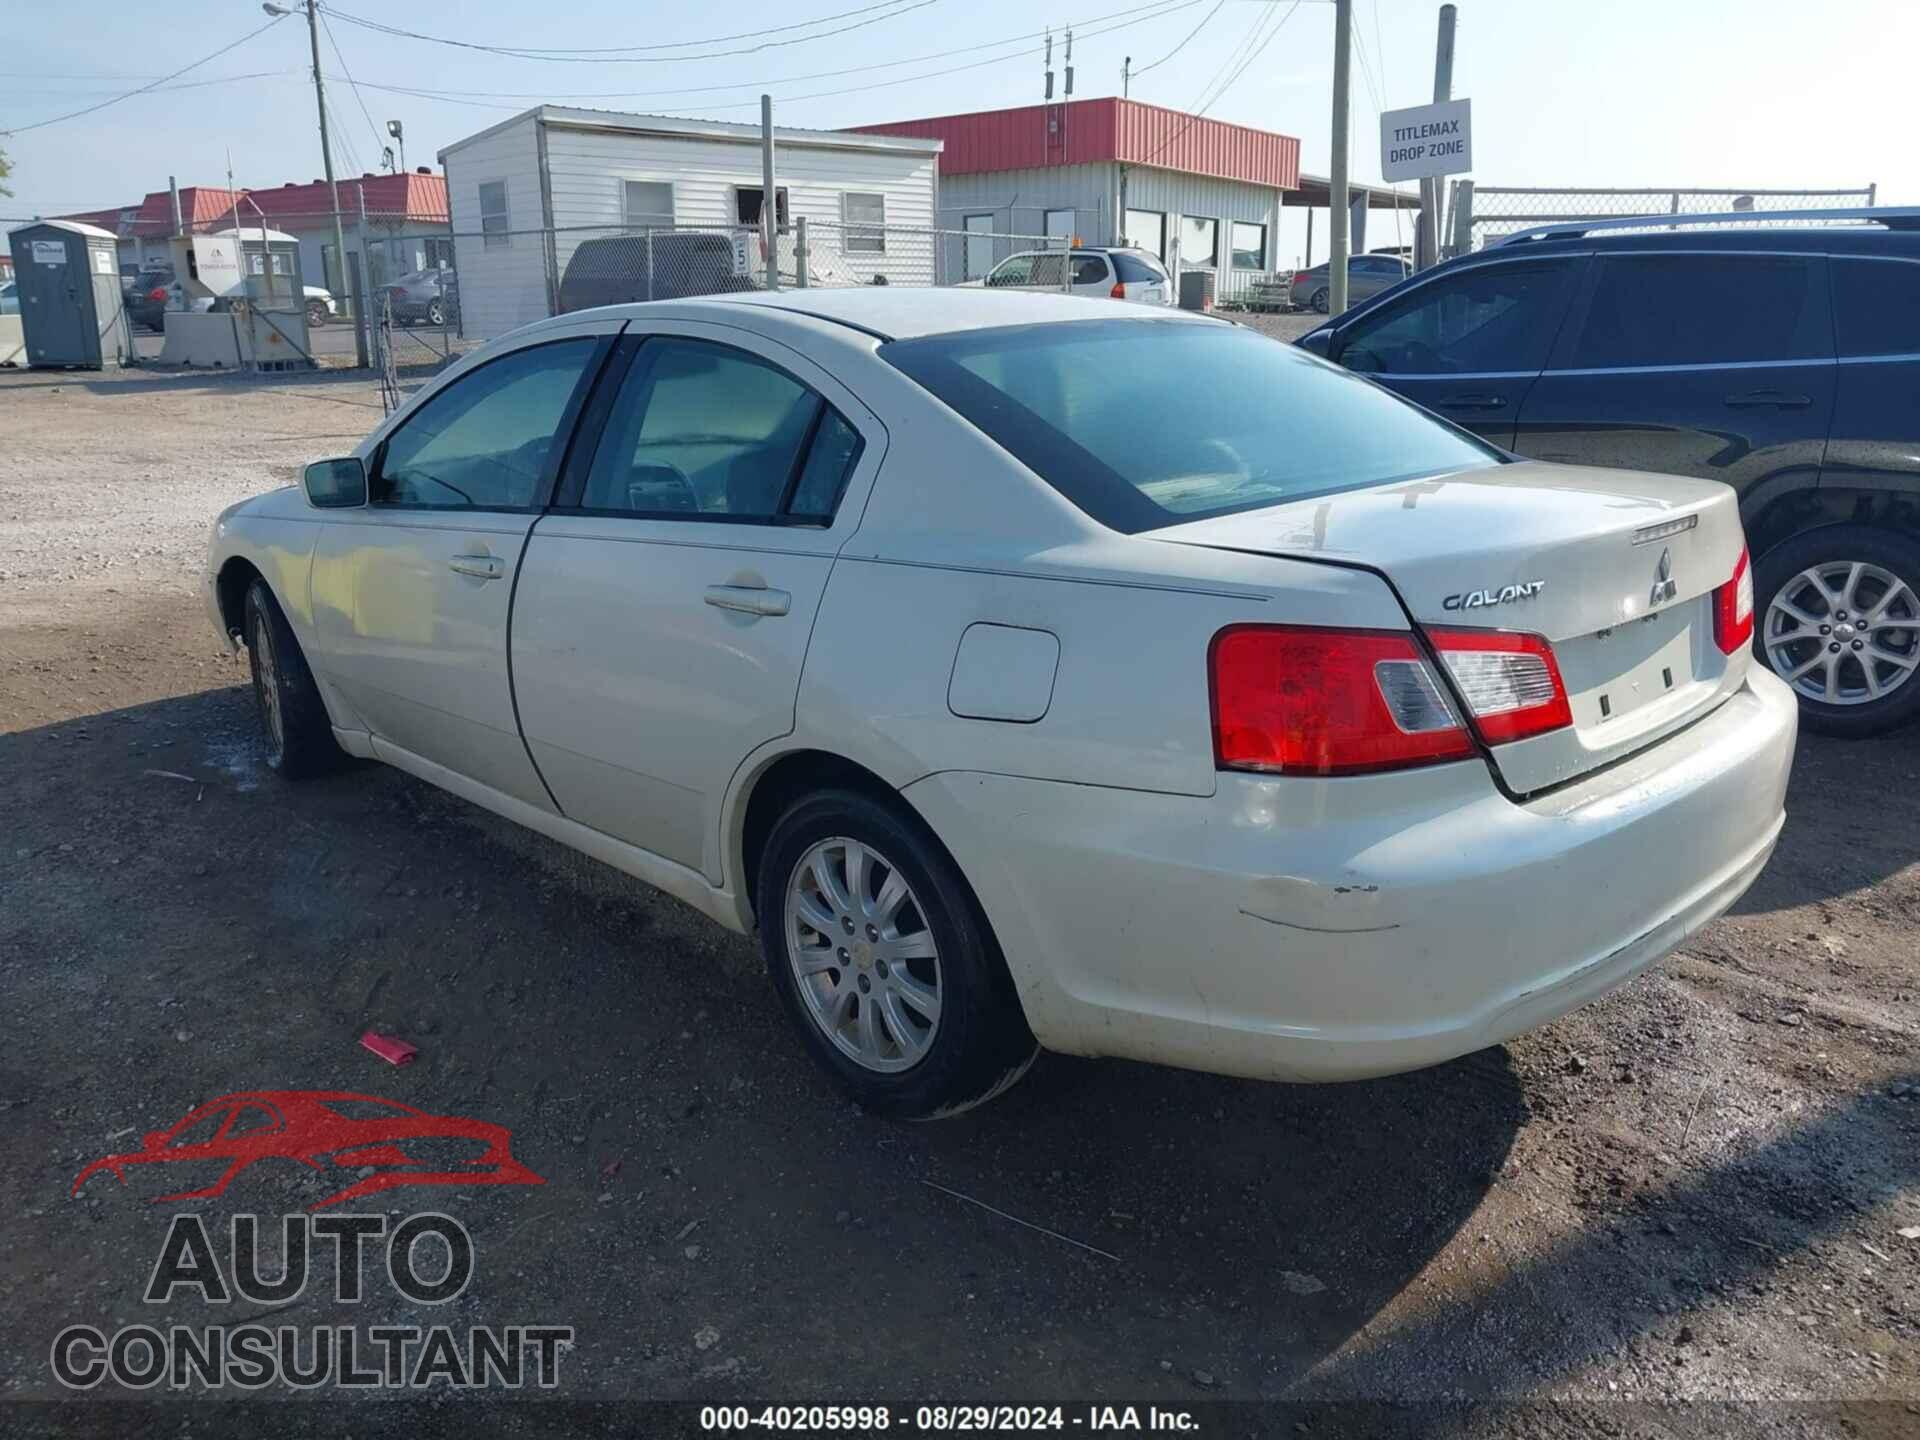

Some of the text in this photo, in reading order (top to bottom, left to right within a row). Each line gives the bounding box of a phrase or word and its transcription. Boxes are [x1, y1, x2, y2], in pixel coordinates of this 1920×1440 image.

[1393, 119, 1459, 142] TITLEMAX
[1390, 139, 1464, 163] DROP ZONE
[1443, 580, 1545, 611] GALANT
